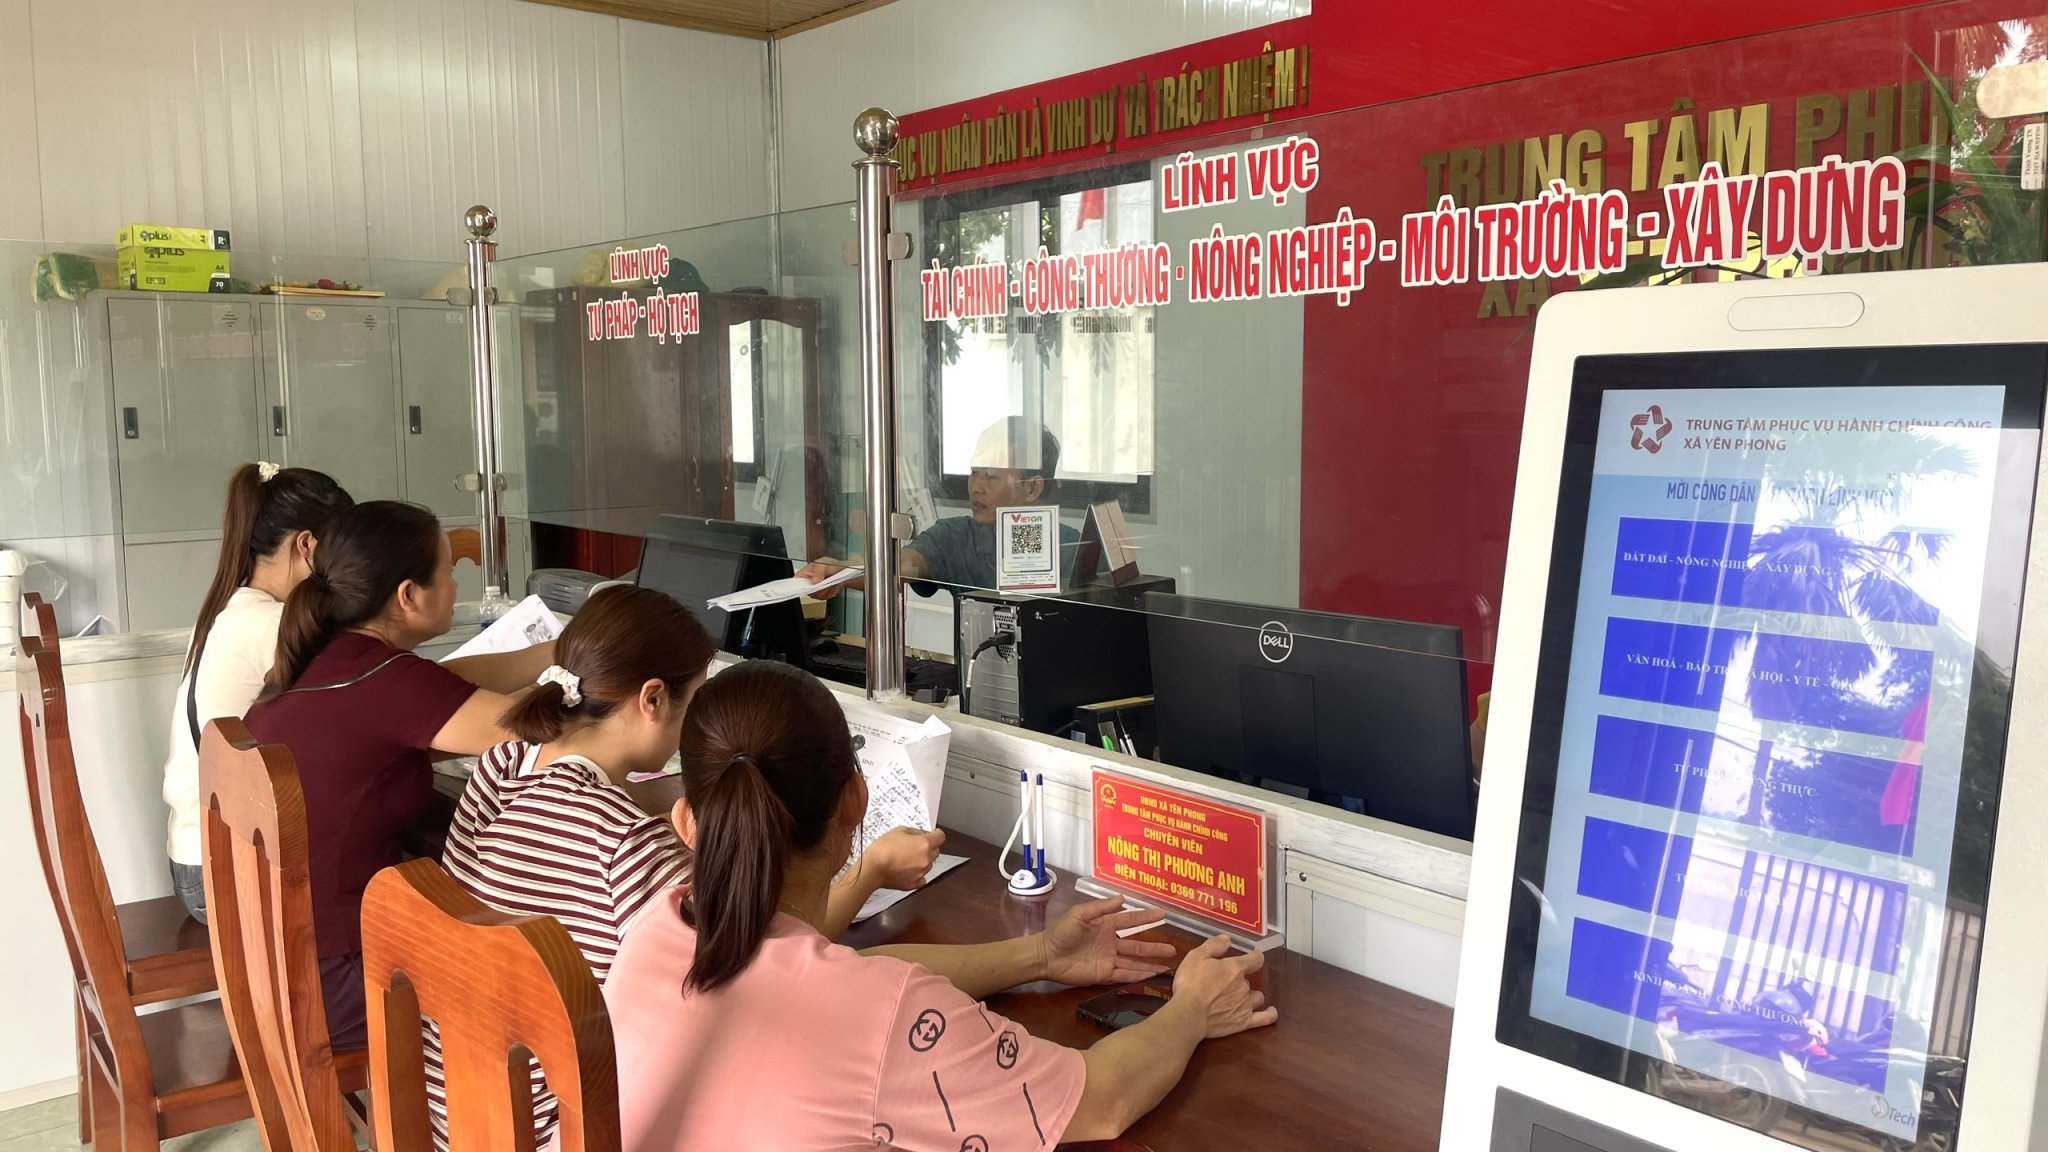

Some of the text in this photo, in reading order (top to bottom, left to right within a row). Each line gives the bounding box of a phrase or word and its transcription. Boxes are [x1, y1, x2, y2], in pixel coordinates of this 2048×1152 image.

[919, 130, 937, 184] VỤ
[942, 113, 982, 173] NHÂN
[985, 104, 1018, 165] DÂN
[1021, 97, 1042, 158] LÀ
[1046, 97, 1085, 153] VINH
[1090, 83, 1119, 153] DỰ
[1123, 71, 1147, 138] VÀ
[1152, 61, 1219, 133] TRÁCH
[1223, 40, 1297, 123] NHIỆM
[1420, 129, 1603, 213] TRUNG
[1624, 95, 1769, 192] TÂM
[1162, 136, 1319, 213] LĨNH VỰC
[921, 258, 950, 321] TÀI
[951, 254, 1008, 320] CHÍNH
[1023, 245, 1079, 315] CÔNG
[1081, 242, 1171, 310] THƯƠNG
[1189, 223, 1263, 302] NÔNG
[1267, 206, 1376, 306] NGHIỆP
[1401, 194, 1470, 287] MÔI
[1474, 178, 1629, 282] TRƯỜNG
[1661, 161, 1758, 269] XÂY
[1762, 154, 1906, 275] DỰNG
[609, 243, 669, 285] LĨNH VỰC
[586, 298, 603, 340] TƯ
[605, 291, 638, 339] PHÁP
[647, 287, 666, 344] HỘ
[667, 292, 699, 344] TỊCH
[1686, 419, 1733, 431] TRUNG
[1736, 417, 1766, 431] TÂM
[1769, 419, 1810, 434] PHỤC
[1813, 419, 1834, 435] VỤ
[1838, 417, 1883, 432] HÀNH
[1684, 437, 1787, 451] XÃ YÊN PHONG
[1667, 481, 1689, 500] MỜI
[1692, 480, 1726, 500] CÔNG
[1730, 481, 1756, 502] DÂN
[1647, 553, 1668, 564] ĐAI
[1263, 635, 1289, 648] DELL
[1627, 653, 1649, 665] VĂN
[1760, 671, 1783, 684] HỘI
[1793, 675, 1801, 685] Y
[1122, 803, 1228, 842] TRUNG TÂM PHỤC VỤ HÀNH CHÍNH CÔNG
[1140, 796, 1157, 808] UBND
[1167, 803, 1181, 815] YÊN
[1183, 809, 1206, 822] PHONG
[1143, 827, 1203, 855] CHUYÊN VIÊN
[1107, 834, 1245, 897] NÔNG THỊ PHƯƠNG ANH
[1114, 863, 1238, 914] ĐIỆN THOẠI: 0369 771 196
[1633, 970, 1663, 987] KINH
